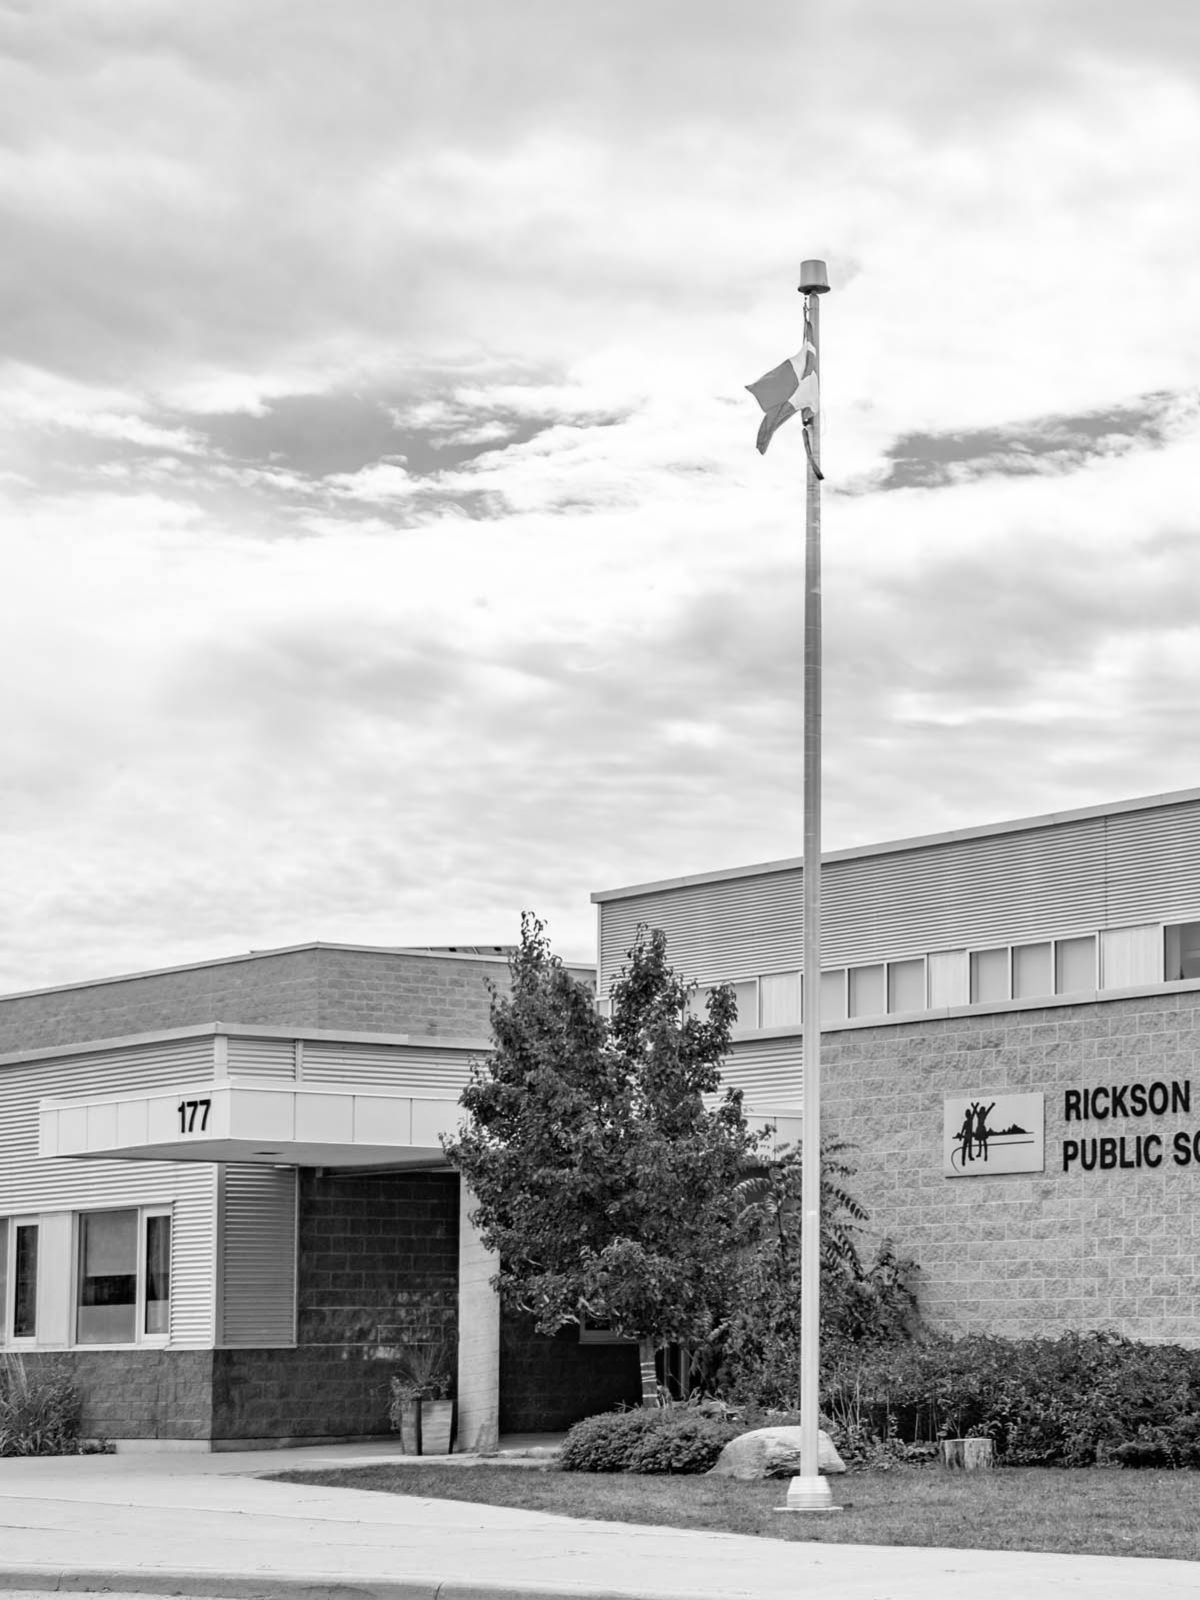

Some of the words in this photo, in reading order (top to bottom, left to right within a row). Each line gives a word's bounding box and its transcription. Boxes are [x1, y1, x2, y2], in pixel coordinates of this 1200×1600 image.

[178, 1099, 211, 1133] 177
[1064, 1080, 1190, 1121] RICKSON
[1062, 1134, 1163, 1172] PUBLIC
